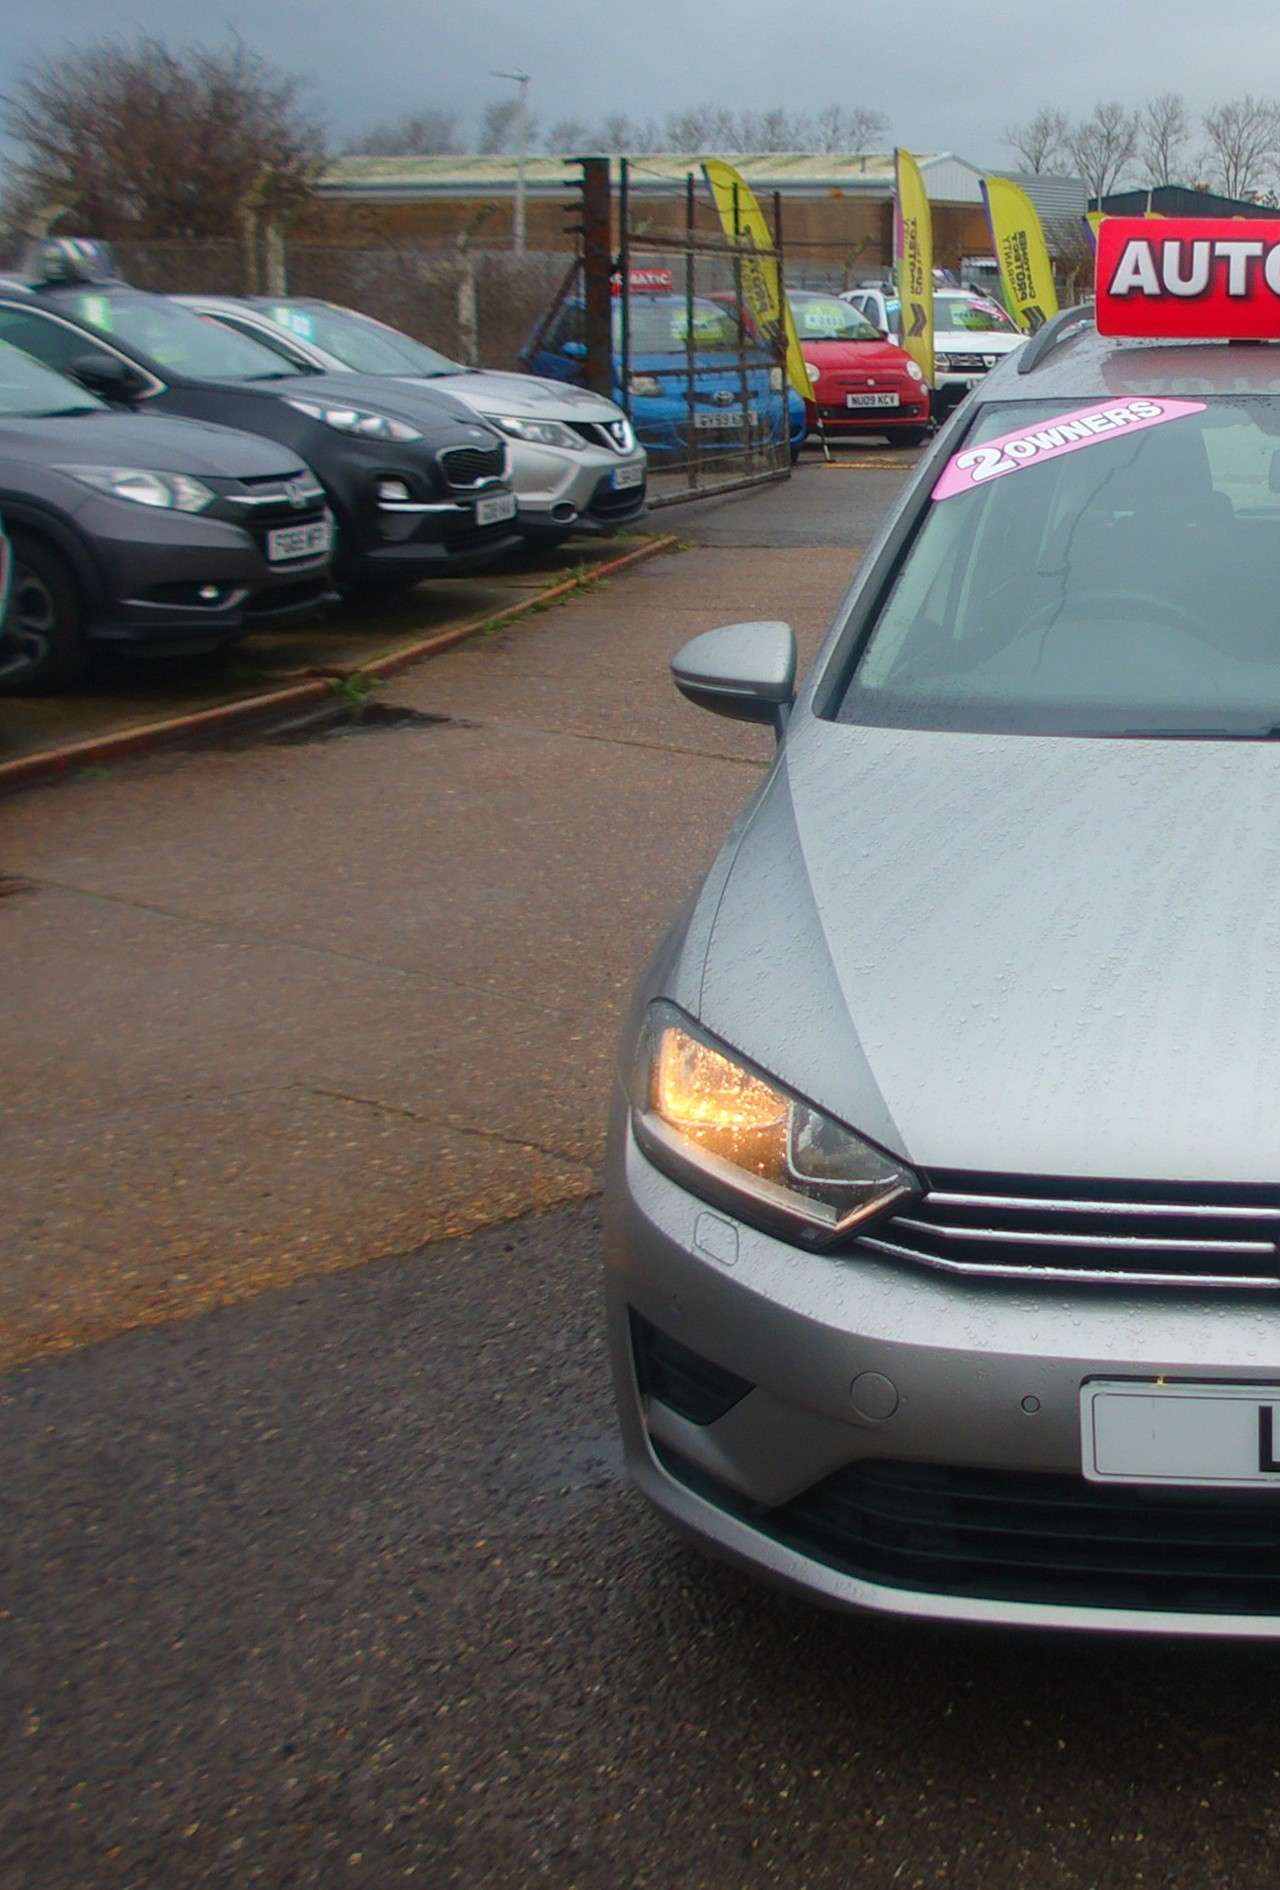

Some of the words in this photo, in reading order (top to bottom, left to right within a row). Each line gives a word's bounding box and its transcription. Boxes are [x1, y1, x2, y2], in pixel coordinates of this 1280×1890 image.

[850, 394, 876, 406] NU09
[878, 394, 897, 406] KCV
[956, 447, 1018, 482] 2
[1003, 401, 1163, 459] OWNERS
